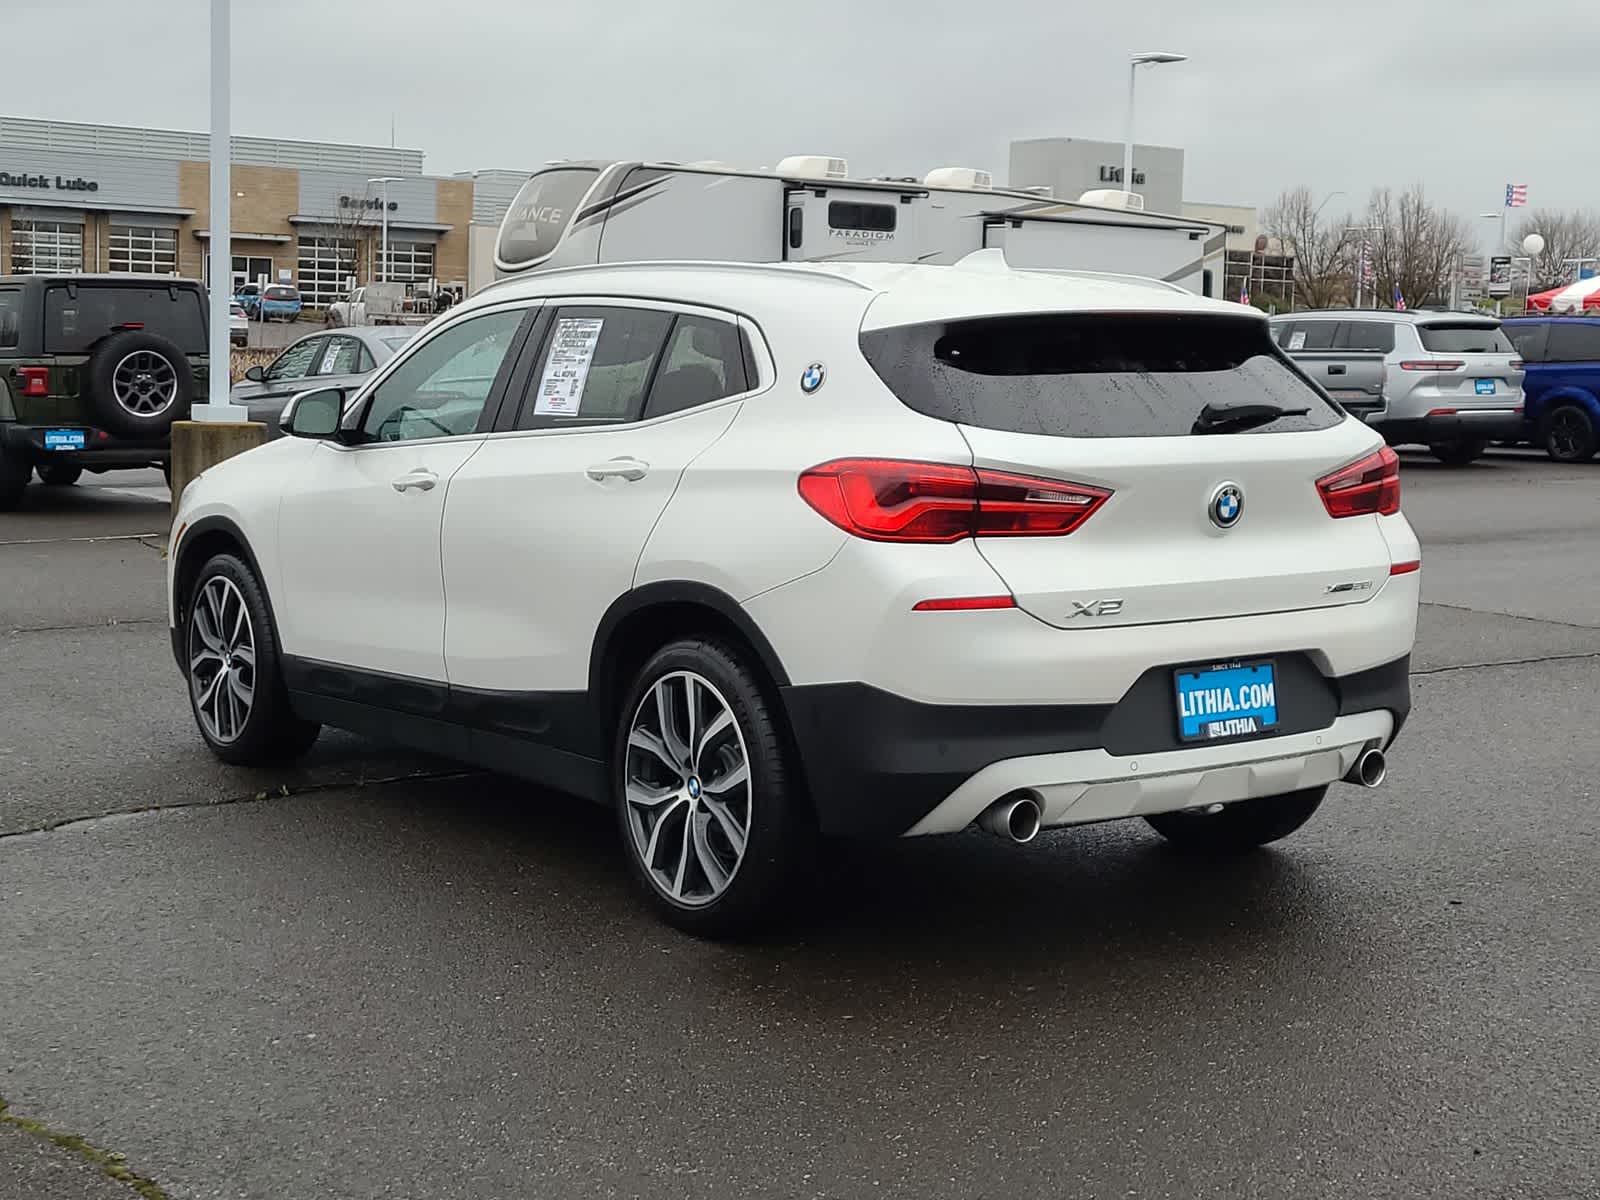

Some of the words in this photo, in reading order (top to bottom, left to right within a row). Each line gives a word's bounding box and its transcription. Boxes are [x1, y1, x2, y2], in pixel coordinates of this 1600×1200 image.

[0, 172, 50, 188] Quick
[56, 175, 98, 192] Lube
[829, 229, 895, 240] PARADIGM
[1063, 599, 1124, 618] X2
[1180, 683, 1275, 717] LITHIA.COM
[1220, 717, 1258, 736] LITHIA
